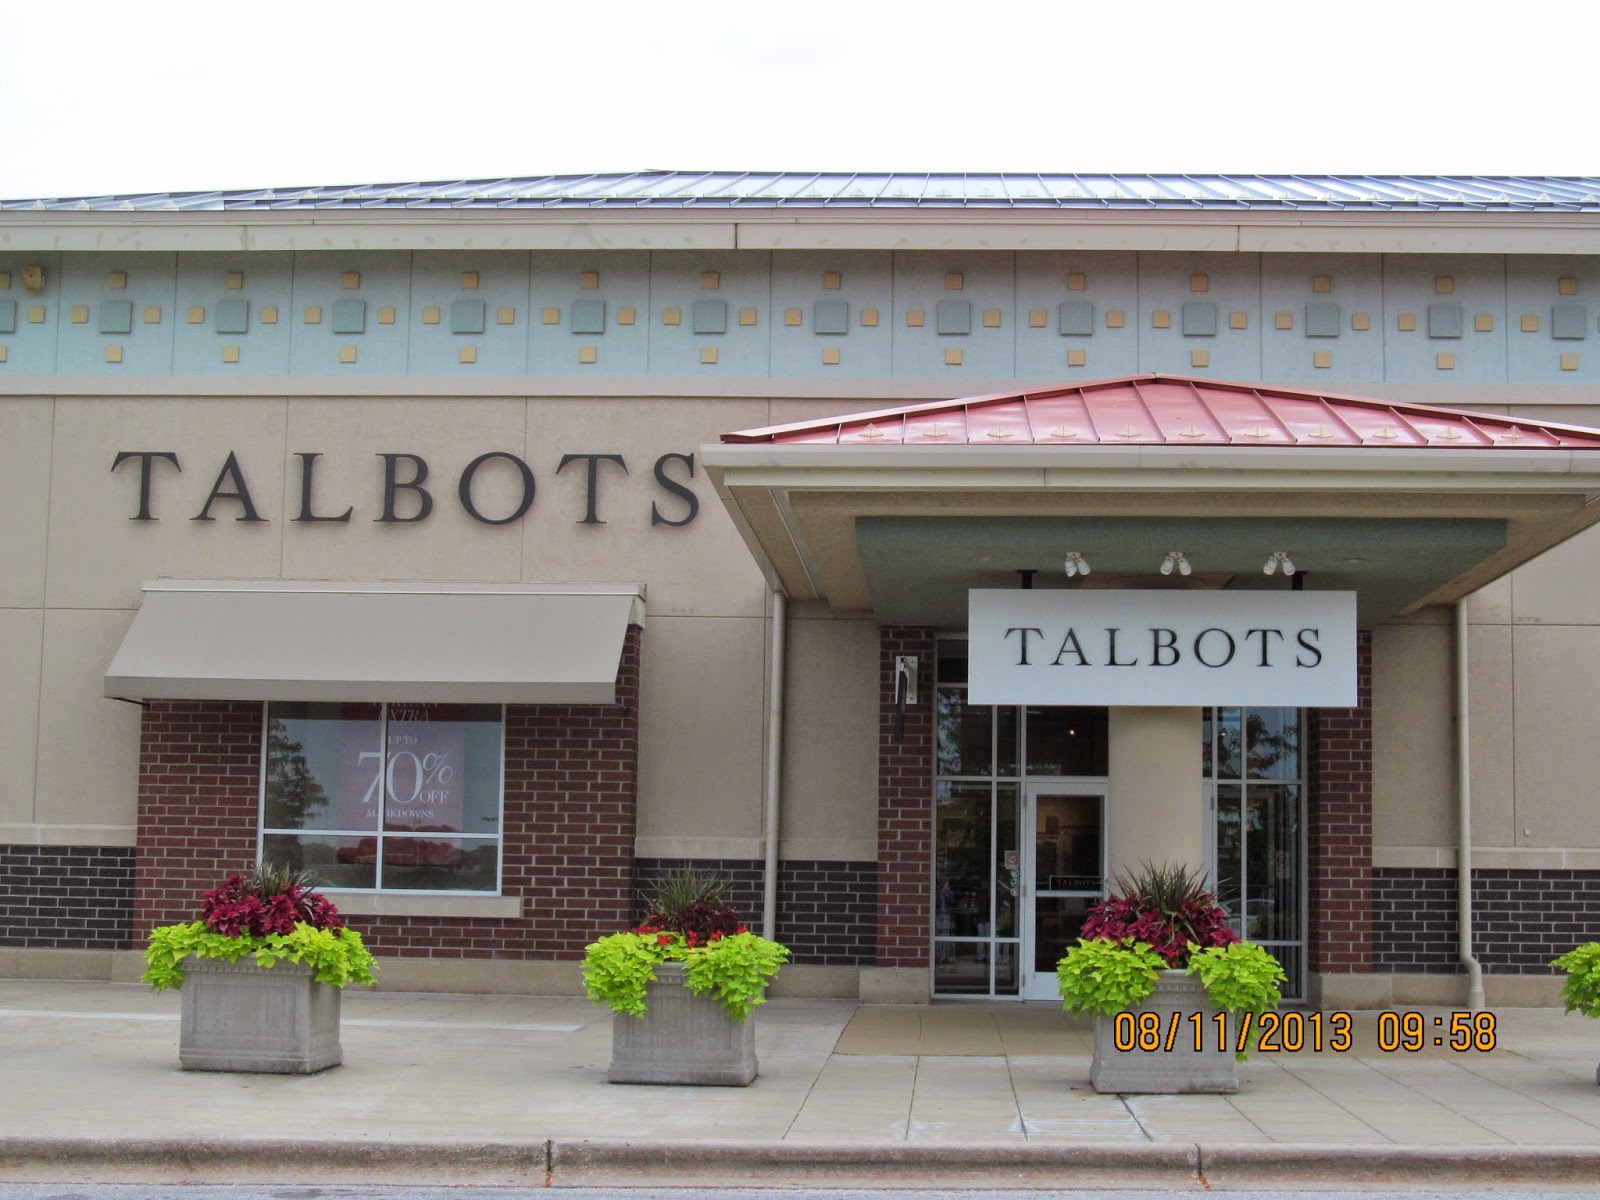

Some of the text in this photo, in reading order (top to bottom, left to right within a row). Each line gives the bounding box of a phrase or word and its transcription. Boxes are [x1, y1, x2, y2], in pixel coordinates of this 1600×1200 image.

[110, 450, 700, 527] TALBOTS
[1004, 627, 1322, 668] TALBOTS
[403, 735, 418, 744] TO
[358, 751, 454, 804] 70%
[419, 790, 450, 804] OFF
[366, 808, 434, 818] MRKDOWNS
